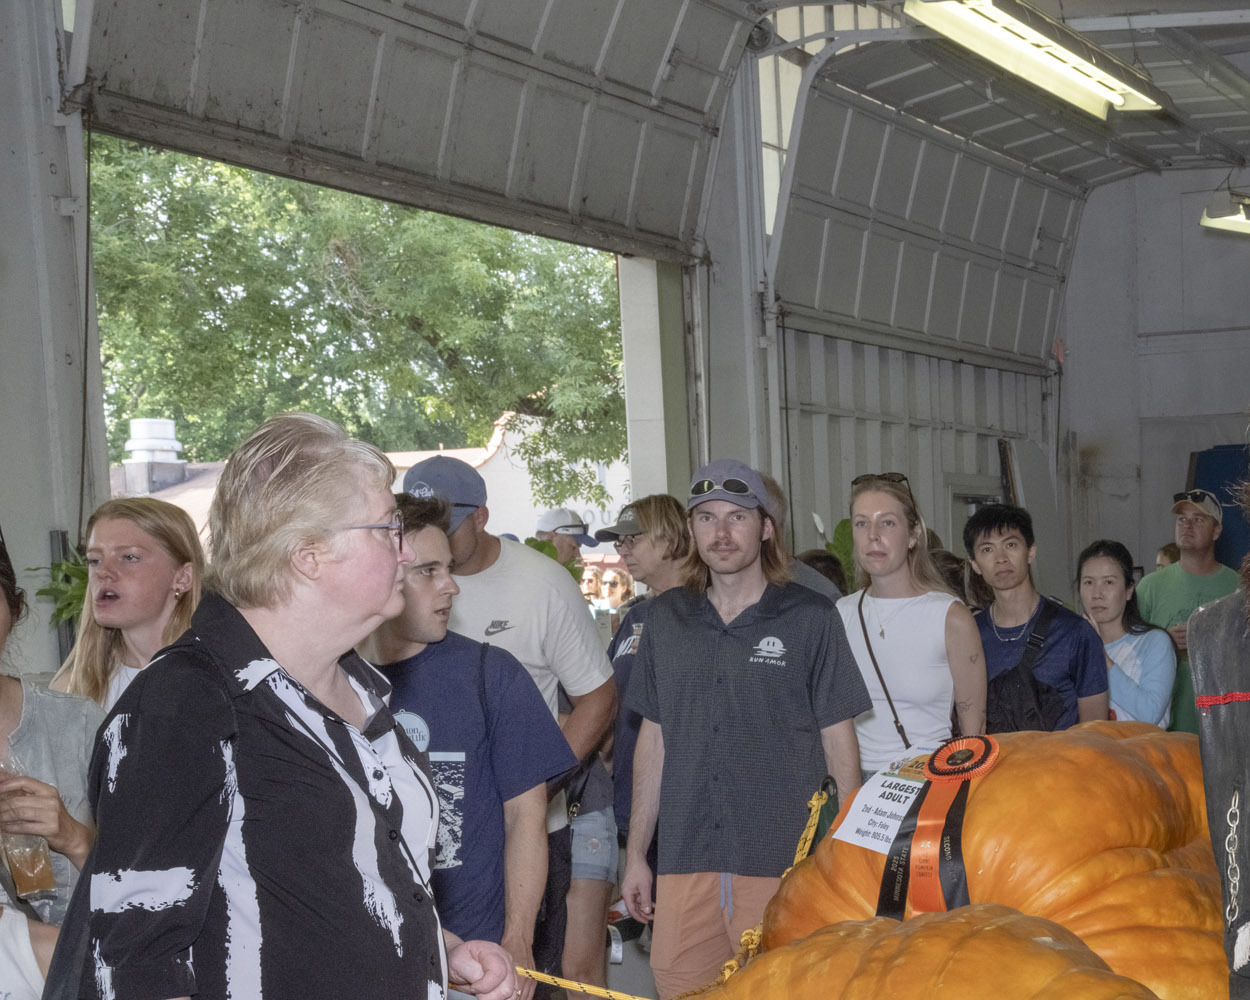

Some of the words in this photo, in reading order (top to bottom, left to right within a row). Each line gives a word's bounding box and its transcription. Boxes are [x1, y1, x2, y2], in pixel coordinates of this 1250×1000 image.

[880, 780, 921, 796] LARGEST
[878, 791, 911, 805] ADULT
[899, 847, 909, 865] STATE
